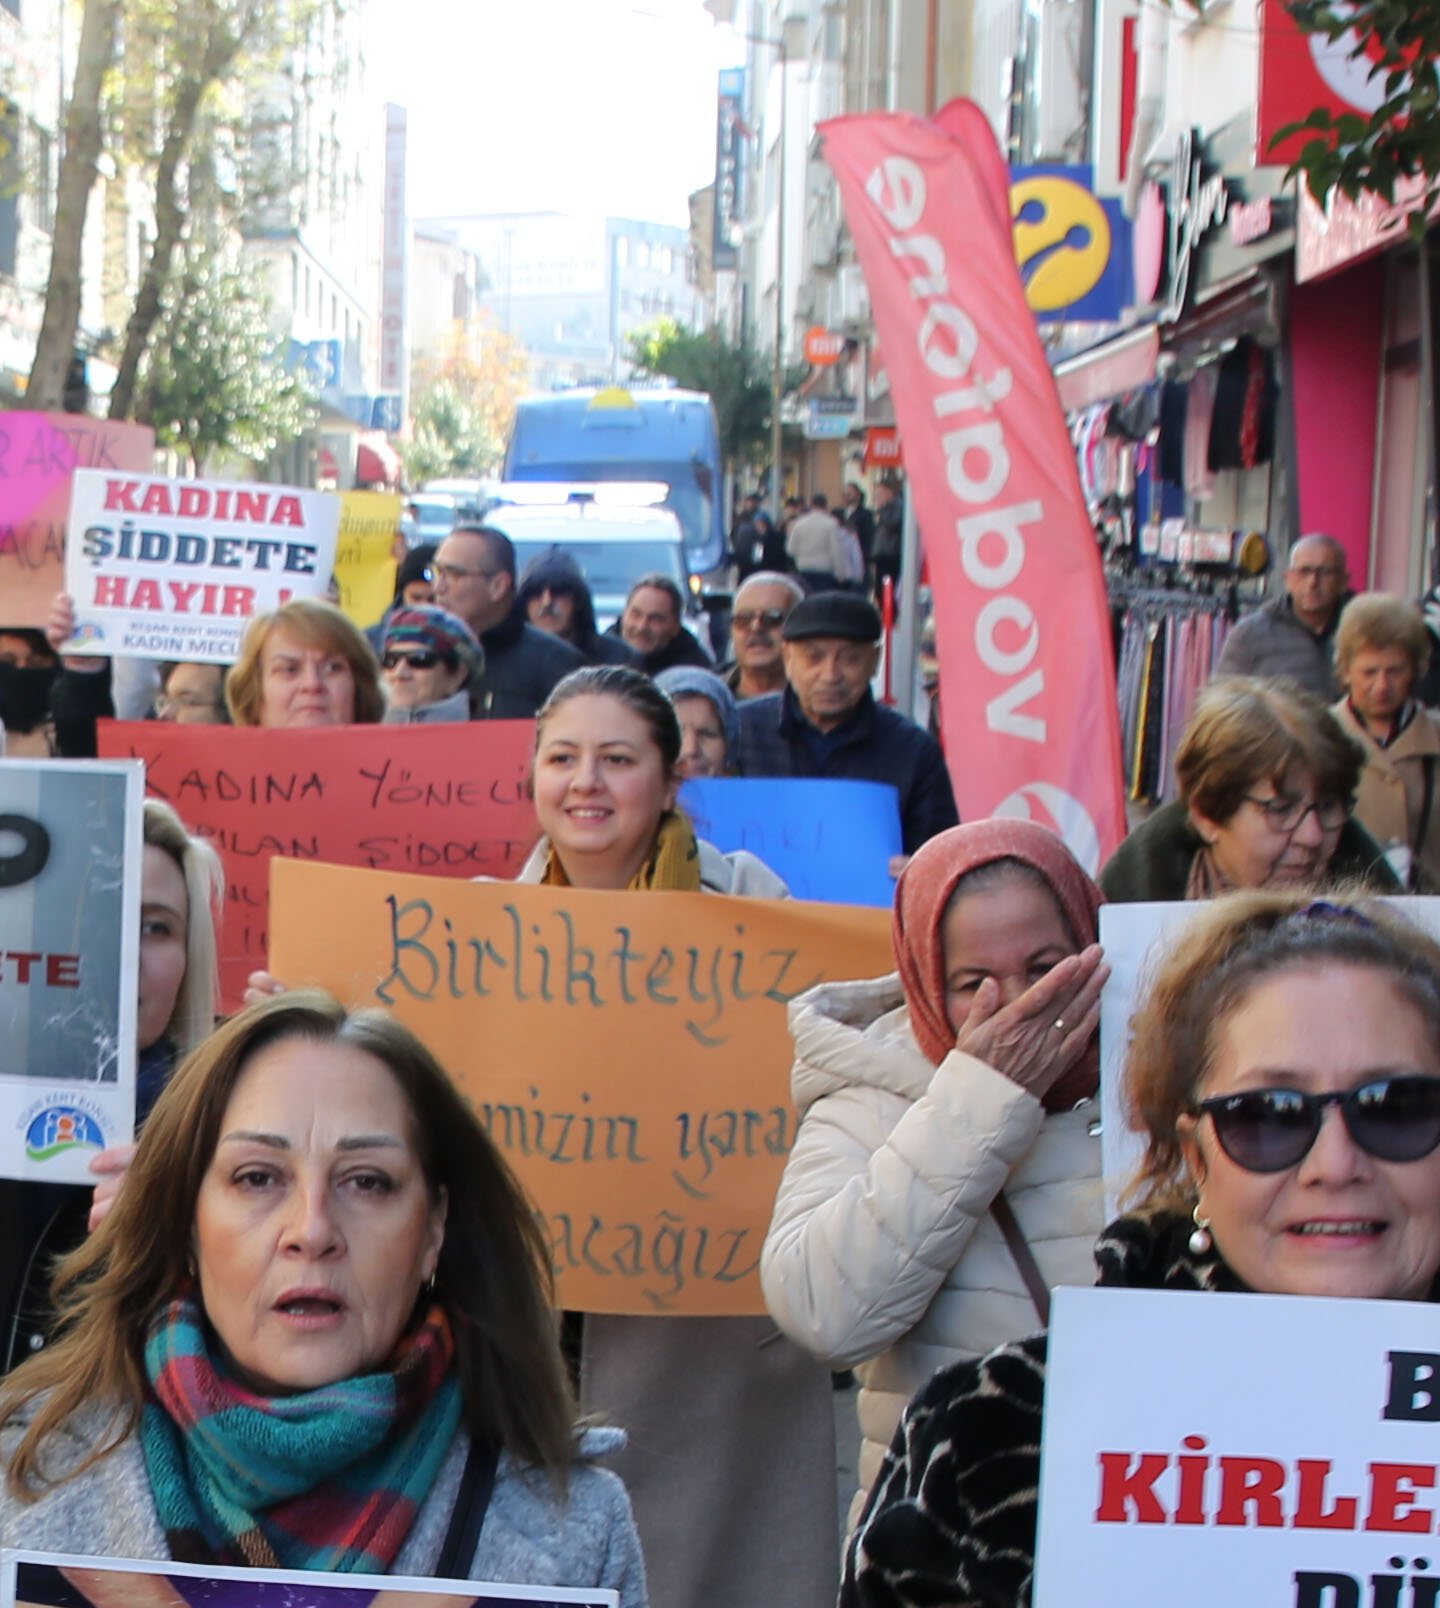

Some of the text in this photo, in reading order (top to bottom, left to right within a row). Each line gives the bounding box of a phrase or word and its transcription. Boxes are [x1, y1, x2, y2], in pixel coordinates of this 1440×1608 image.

[102, 478, 307, 529] KADINA
[82, 519, 320, 576] ŞİDDETE
[91, 574, 258, 617] HAYIR
[122, 633, 184, 652] KADIN
[373, 892, 826, 1048] Birlikteyiz
